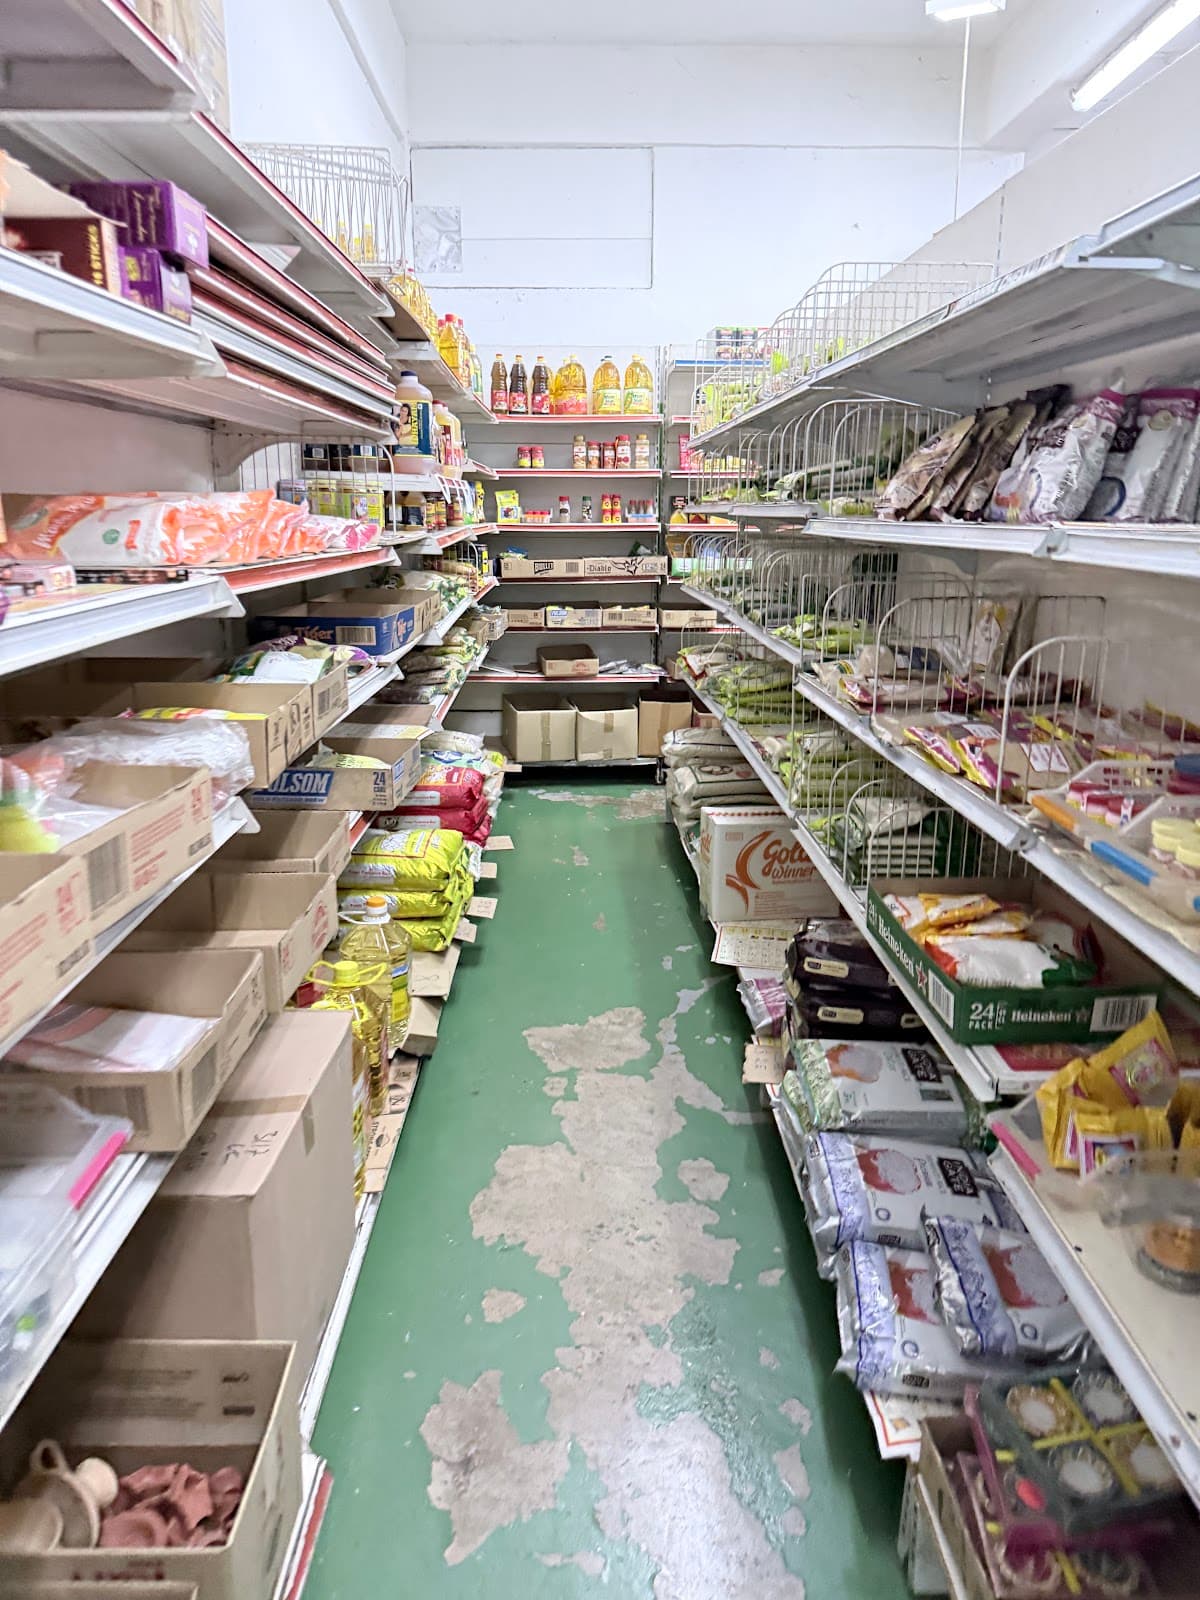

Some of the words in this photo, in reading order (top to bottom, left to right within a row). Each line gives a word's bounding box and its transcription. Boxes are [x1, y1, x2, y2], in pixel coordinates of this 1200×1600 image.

[295, 625, 334, 641] Tiger
[372, 771, 386, 786] 24
[878, 915, 915, 977] Heineken
[970, 1002, 994, 1021] 24
[1011, 1009, 1072, 1023] Heineken
[968, 1020, 993, 1030] PACK
